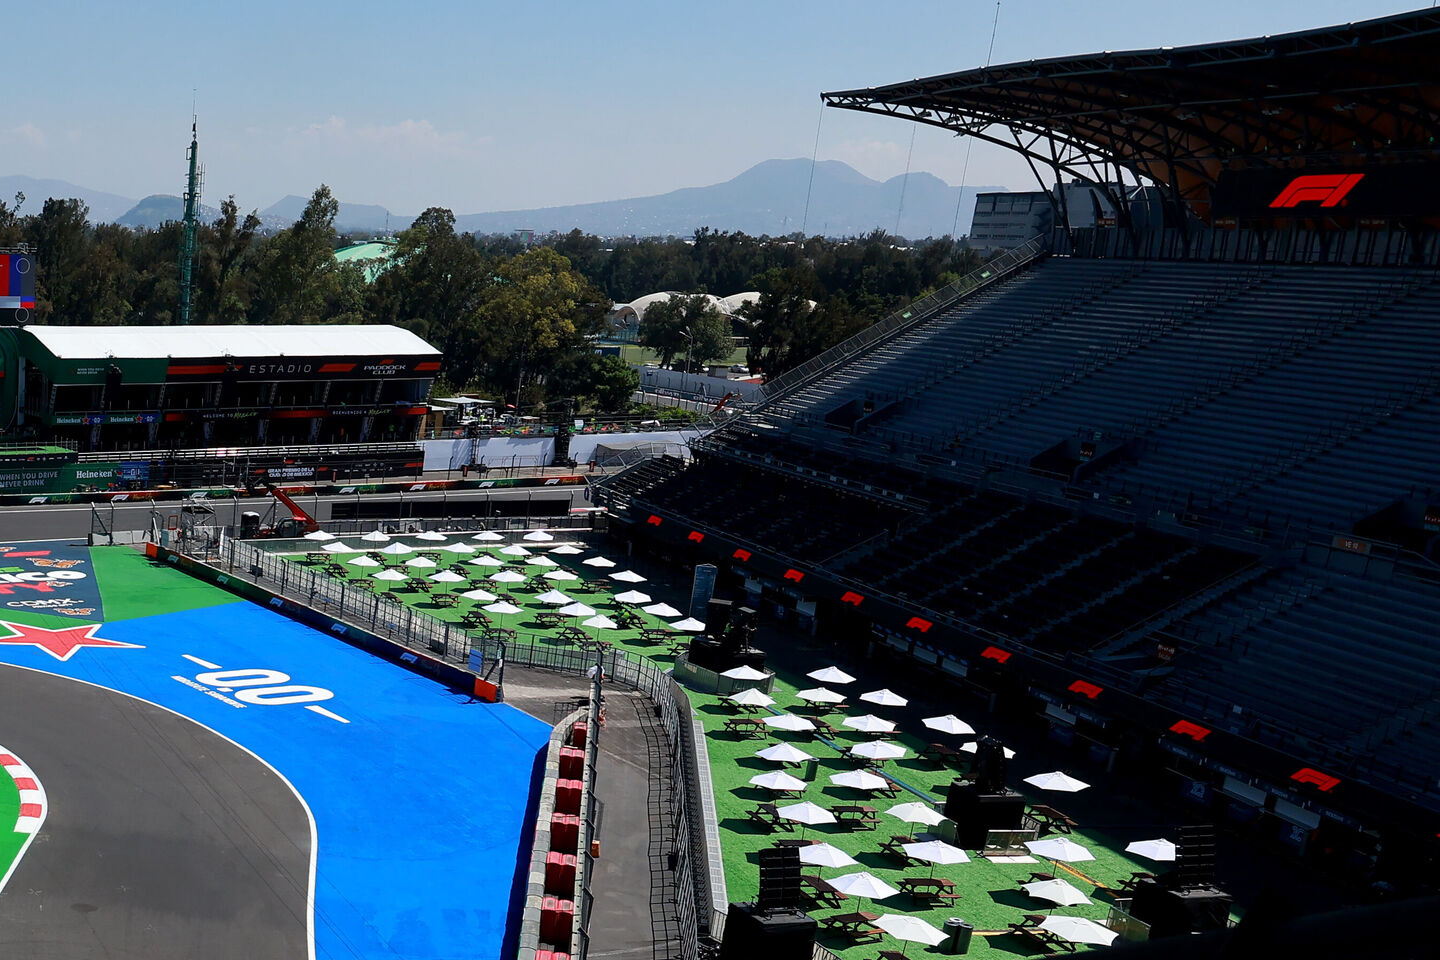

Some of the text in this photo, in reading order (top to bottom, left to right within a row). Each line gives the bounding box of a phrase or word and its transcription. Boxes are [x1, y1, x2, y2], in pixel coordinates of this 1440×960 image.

[250, 364, 312, 374] ESTADIO
[22, 472, 36, 480] YOU
[37, 471, 59, 479] DRIVE
[76, 469, 112, 479] Heineken
[23, 479, 45, 487] DRINK
